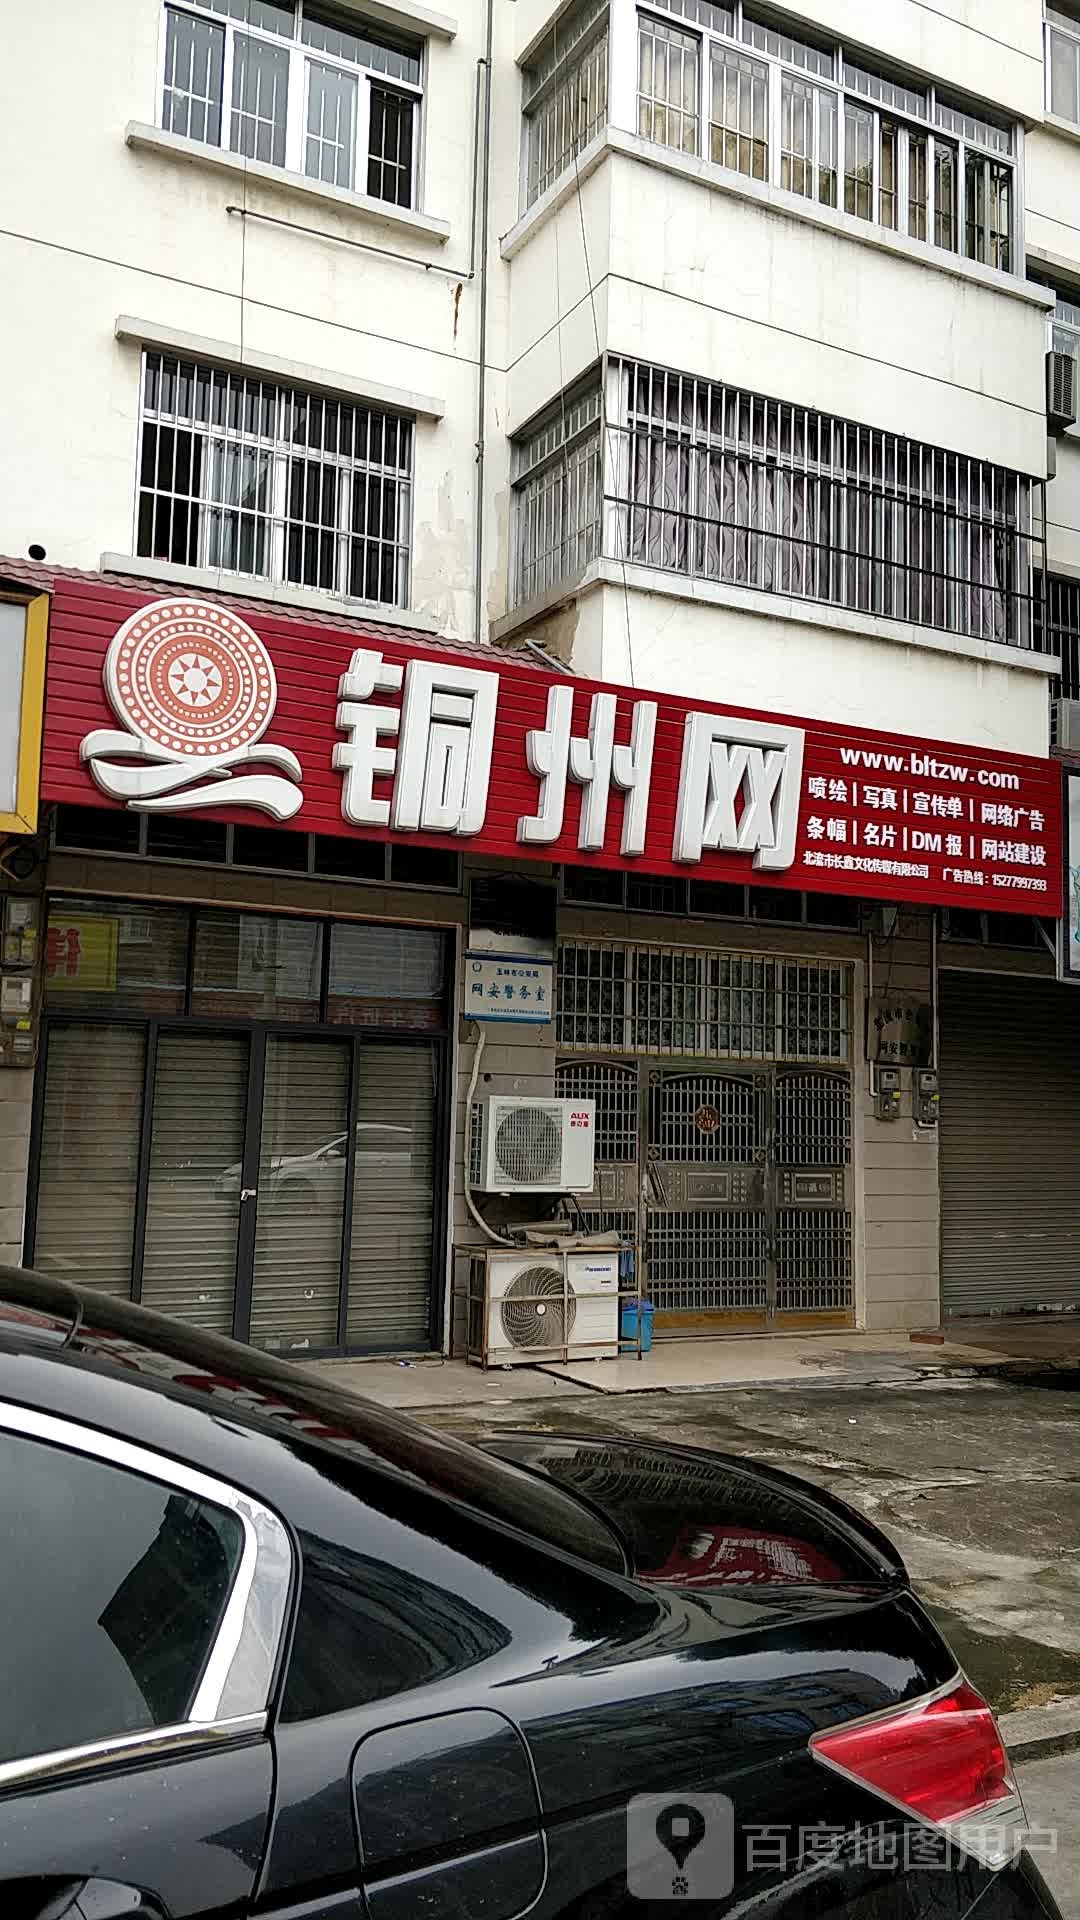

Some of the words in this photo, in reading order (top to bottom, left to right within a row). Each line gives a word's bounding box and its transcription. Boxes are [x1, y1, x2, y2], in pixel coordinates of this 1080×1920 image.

[331, 648, 806, 873] 铜州网
[840, 747, 1020, 790] www.bltzw.com
[807, 777, 848, 803] 喷绘
[862, 786, 898, 811] 写真
[912, 792, 964, 819] 宣传单
[981, 803, 1045, 832] 网络广告
[802, 850, 929, 879] 北流市长鑫文化传媒有限公司
[806, 816, 847, 842] 条幅
[863, 823, 897, 848] 名片
[981, 839, 1047, 867] 网站建设
